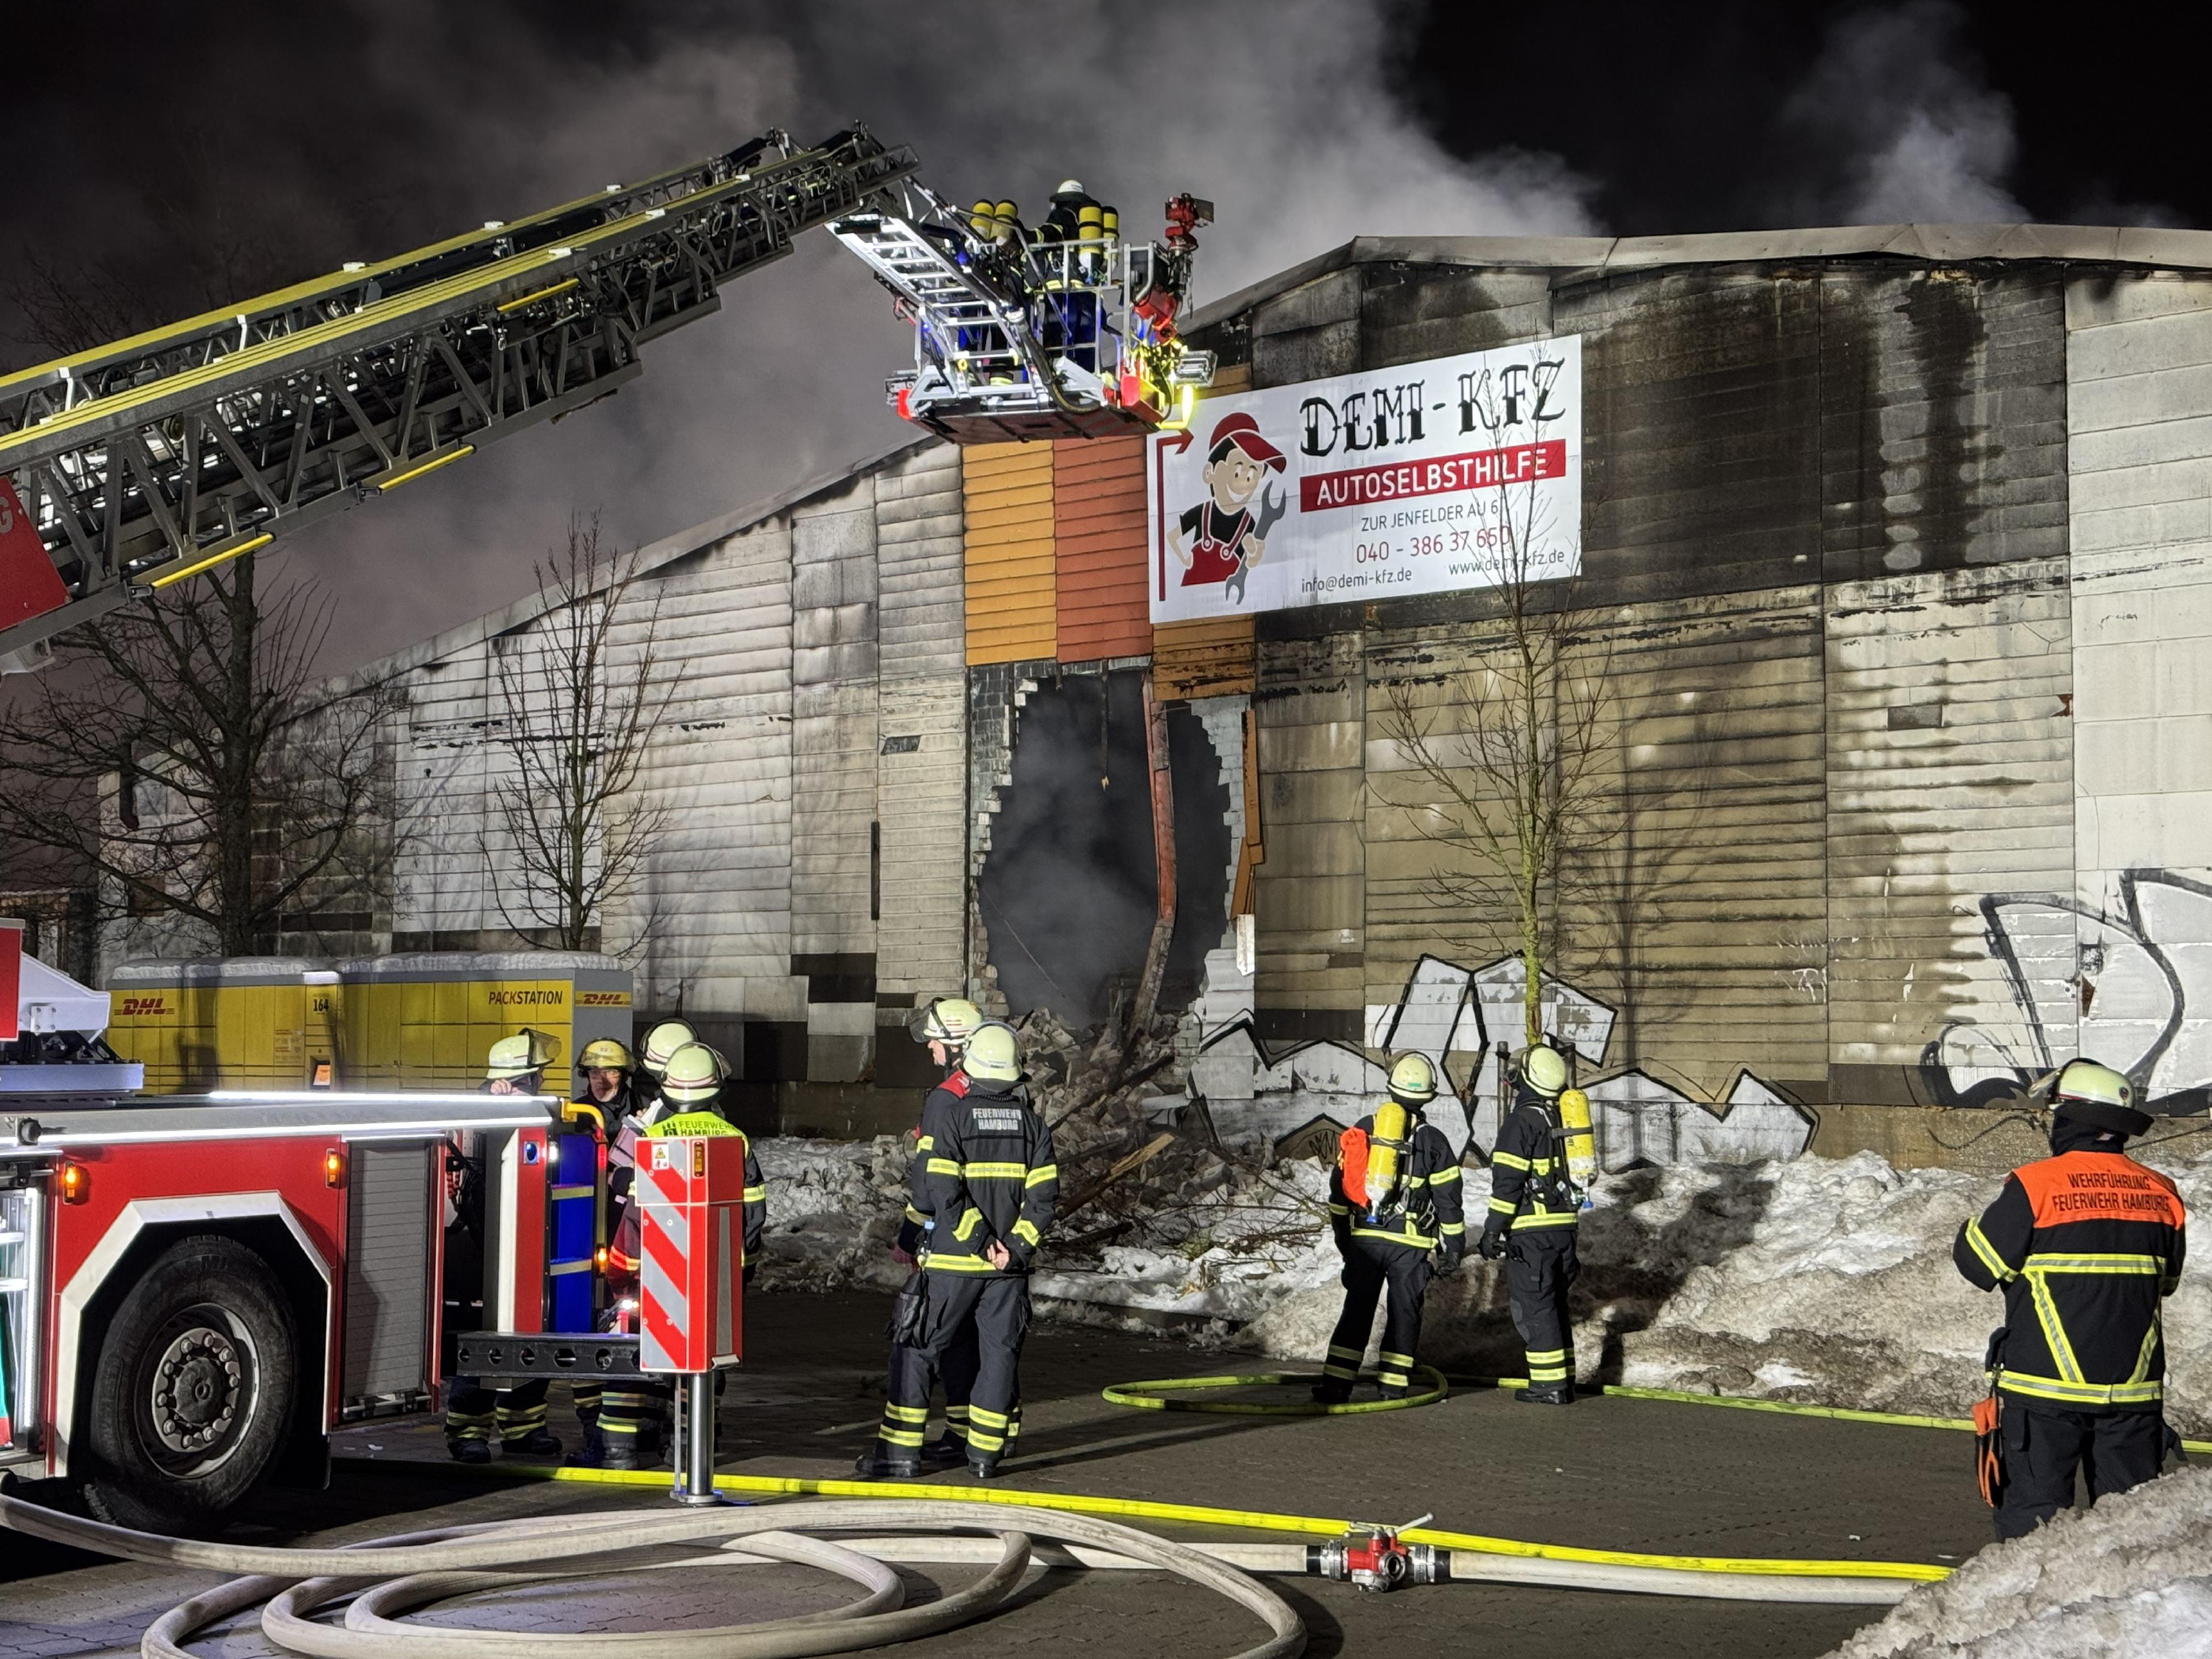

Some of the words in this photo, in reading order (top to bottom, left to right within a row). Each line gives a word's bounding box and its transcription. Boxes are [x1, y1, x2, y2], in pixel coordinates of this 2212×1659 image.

[1317, 448, 1547, 506] AUTOSELBSTHILFE
[1361, 515, 1387, 532] ZUR
[1390, 505, 1463, 528] JENFELDER
[1469, 501, 1487, 516] AU
[1491, 499, 1499, 514] 6
[1356, 541, 1390, 563] 040
[1410, 534, 1443, 557] 386
[1449, 530, 1469, 551] 37
[1449, 548, 1565, 576] www.dem-kfz.de
[1302, 567, 1413, 593] info@demi-kfz.de
[122, 998, 167, 1016] DHL
[313, 999, 329, 1012] 164
[488, 991, 562, 1005] PACKSTATION
[583, 993, 623, 1006] DHL
[972, 1108, 1022, 1120] FEUERWEHR
[978, 1119, 1019, 1130] HAMBURG
[2067, 1168, 2151, 1191] WEHRFÜHRUNG
[2052, 1192, 2120, 1212] FEUERWEHR
[2121, 1193, 2170, 1212] HAMBURG
